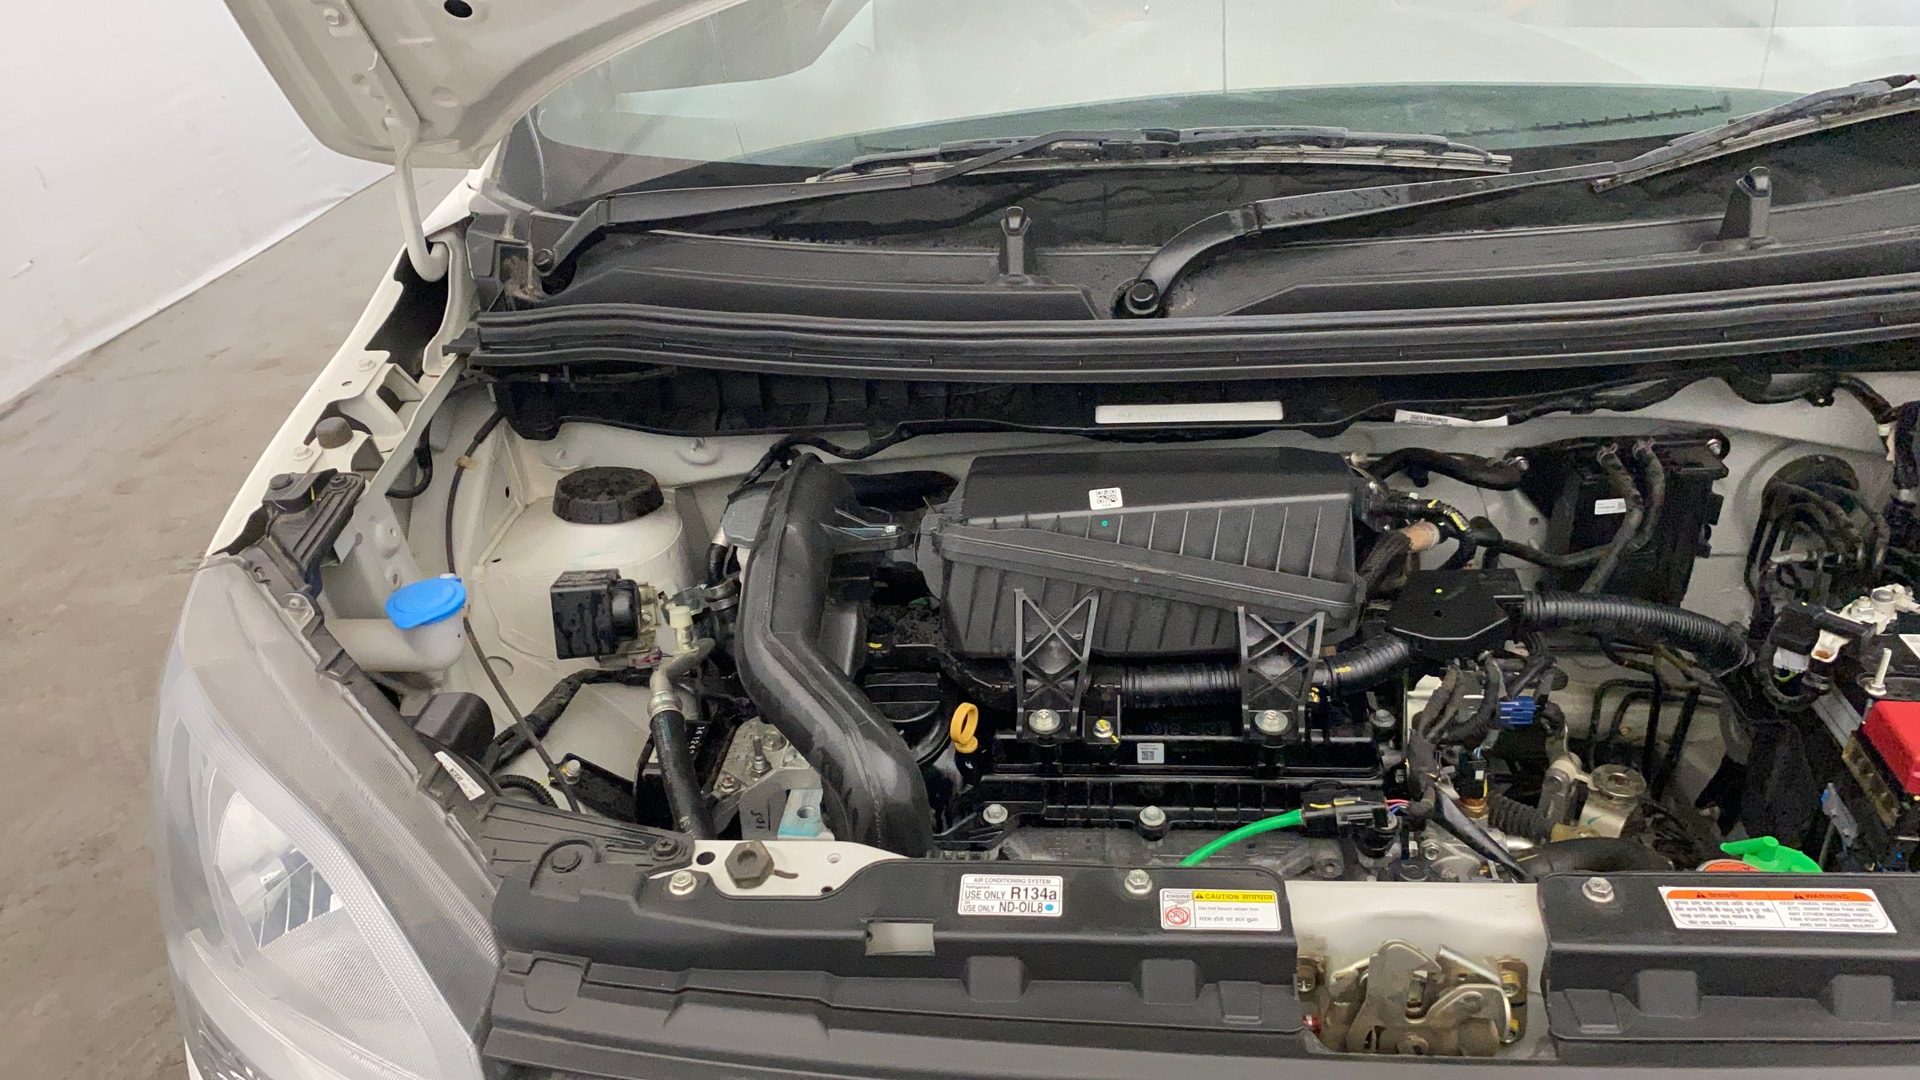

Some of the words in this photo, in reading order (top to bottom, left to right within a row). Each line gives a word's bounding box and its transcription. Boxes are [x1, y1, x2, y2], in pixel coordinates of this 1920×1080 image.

[965, 890, 981, 899] USE
[984, 891, 1006, 899] ONLY
[1011, 886, 1057, 900] R134a
[999, 901, 1043, 913] ND-OIL8
